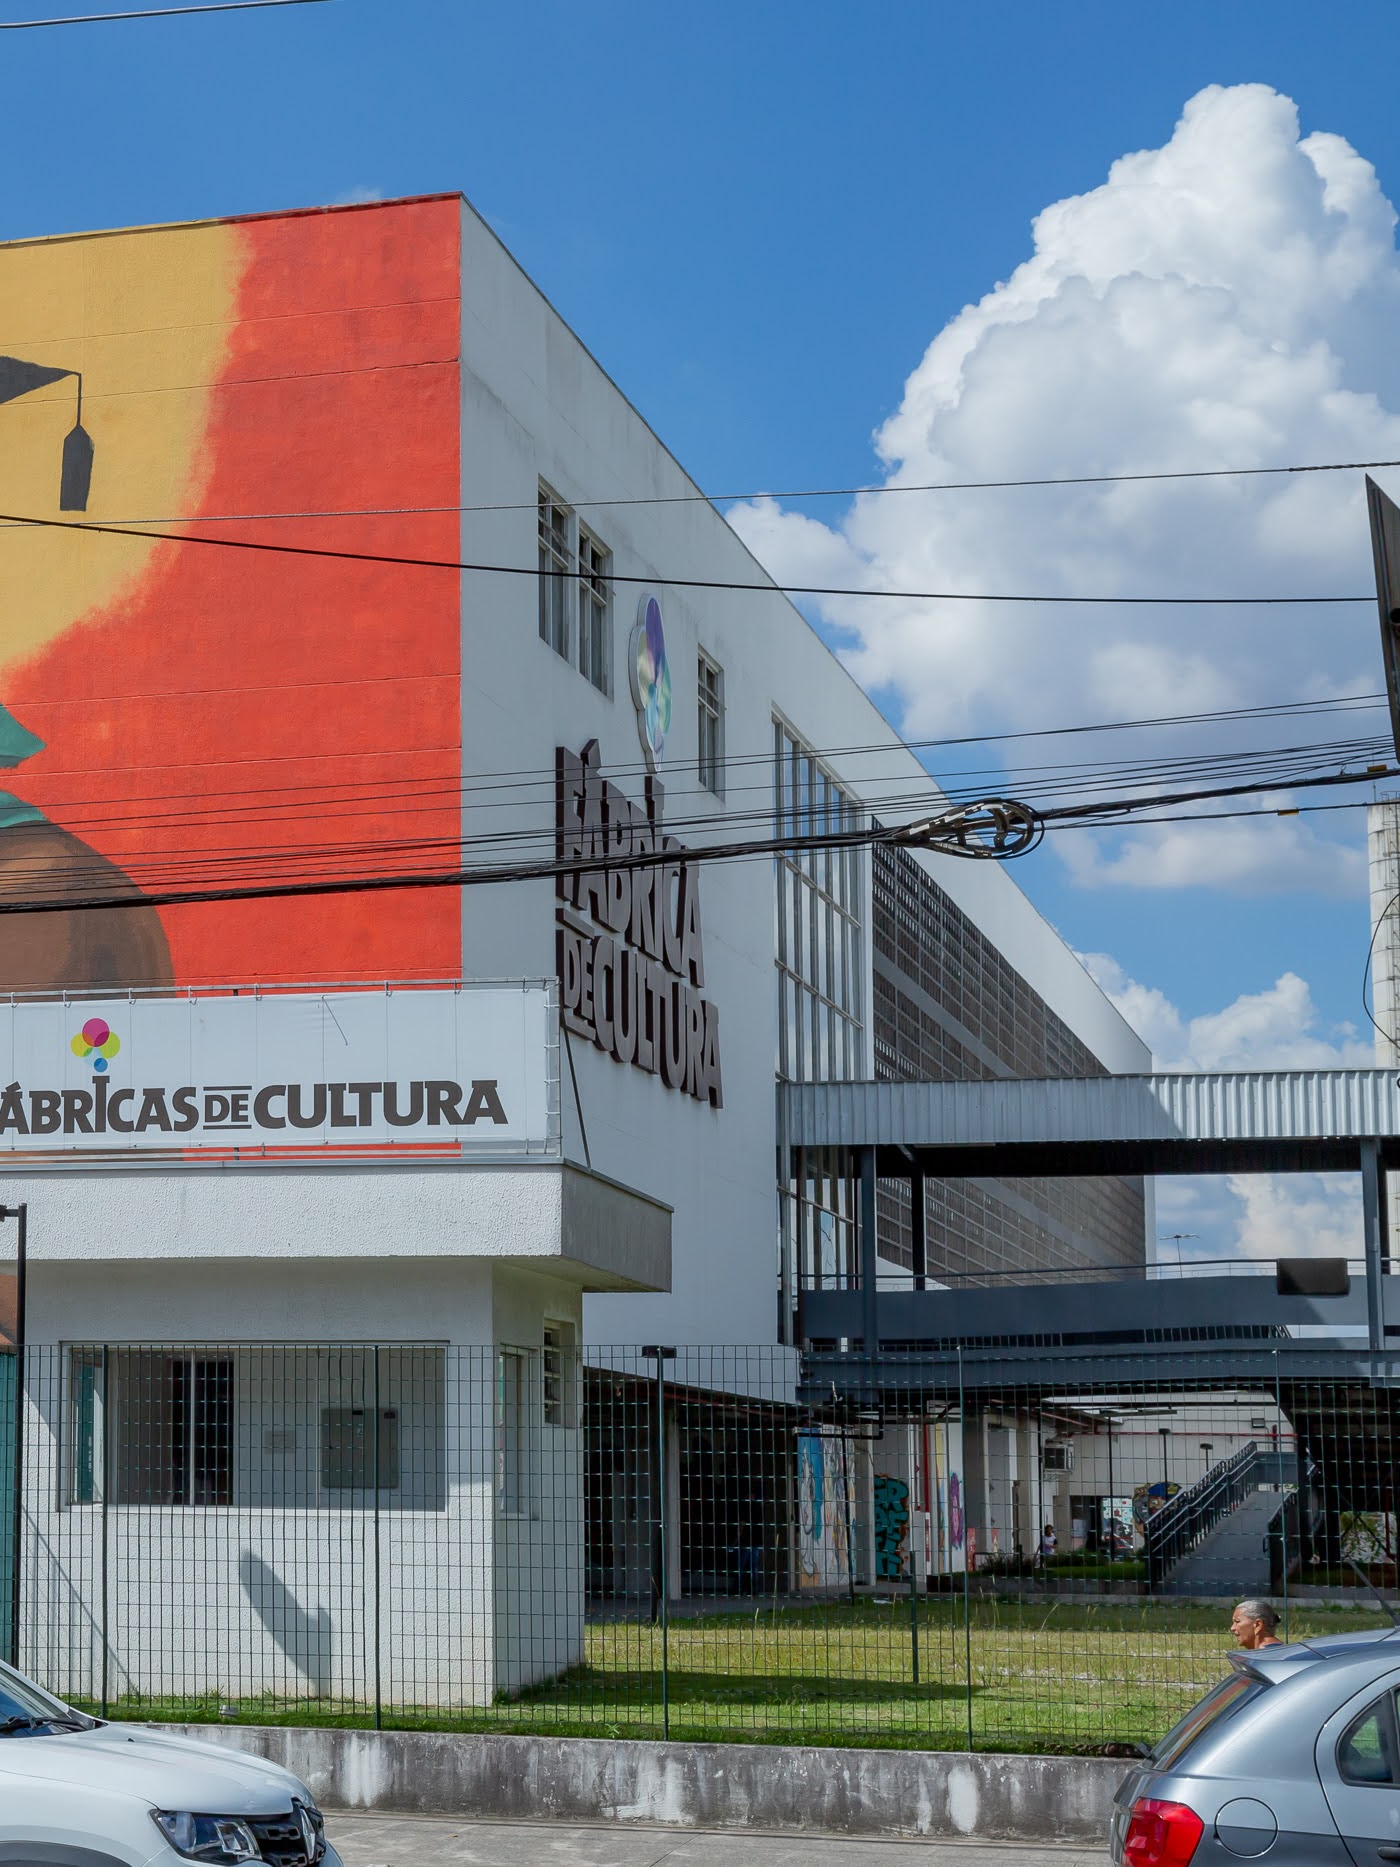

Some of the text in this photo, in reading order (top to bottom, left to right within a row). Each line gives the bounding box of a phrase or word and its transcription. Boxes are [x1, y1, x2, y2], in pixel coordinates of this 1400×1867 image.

[555, 738, 704, 988] FÁBRICA
[204, 1094, 250, 1123] DE
[255, 1079, 509, 1130] CULTURA
[555, 929, 723, 1109] DE CULTURA
